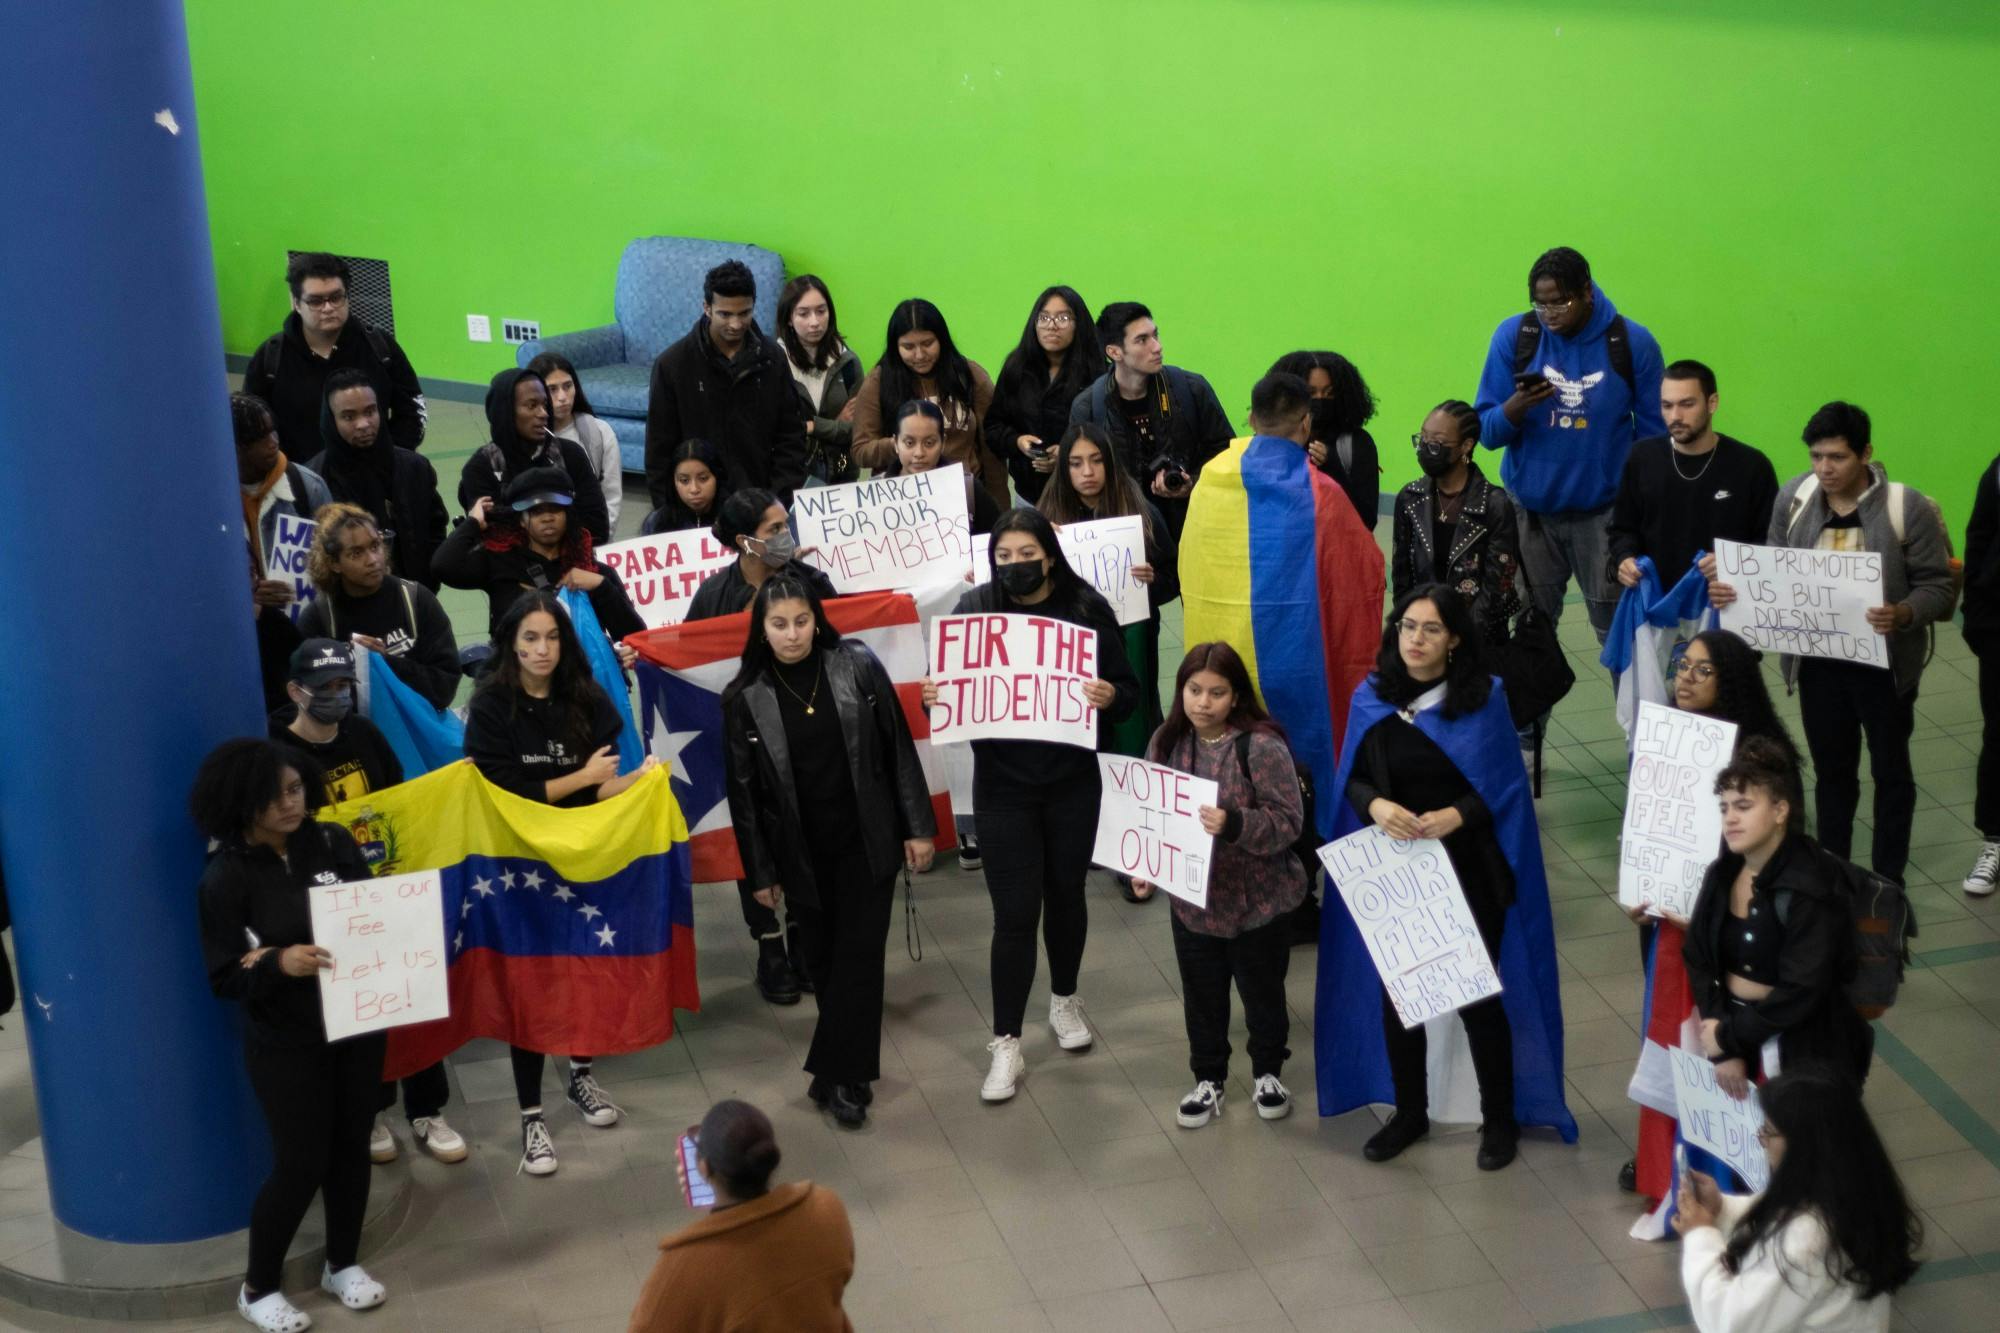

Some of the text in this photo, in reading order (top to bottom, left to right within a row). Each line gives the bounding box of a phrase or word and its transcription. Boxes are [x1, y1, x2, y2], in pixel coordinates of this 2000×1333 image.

[797, 472, 933, 517] WE MARCH
[821, 499, 939, 543] FOR OUR
[606, 542, 684, 578] PARA
[816, 514, 971, 580] MEMBERS
[1722, 543, 1881, 583] UB PROMOTES
[622, 567, 721, 607] ULT
[1747, 580, 1837, 608] US BUT
[1741, 625, 1835, 656] SUPPORT
[1754, 606, 1841, 632] DOESN'T
[937, 616, 1094, 679] FOR THE
[1637, 706, 1725, 768] IT'S
[1108, 761, 1192, 817] VOTE
[1632, 755, 1701, 801] OUR
[1139, 806, 1172, 837] IT
[1630, 793, 1697, 844] FEE
[1121, 829, 1182, 882] OUT
[1624, 840, 1670, 874] LET
[325, 886, 383, 913] It's
[1353, 851, 1450, 921] OUR
[347, 913, 386, 937] Fee
[331, 949, 387, 983] Let
[1391, 953, 1467, 1001] LET
[355, 978, 413, 1022] Be!
[1683, 1099, 1721, 1147] WE
